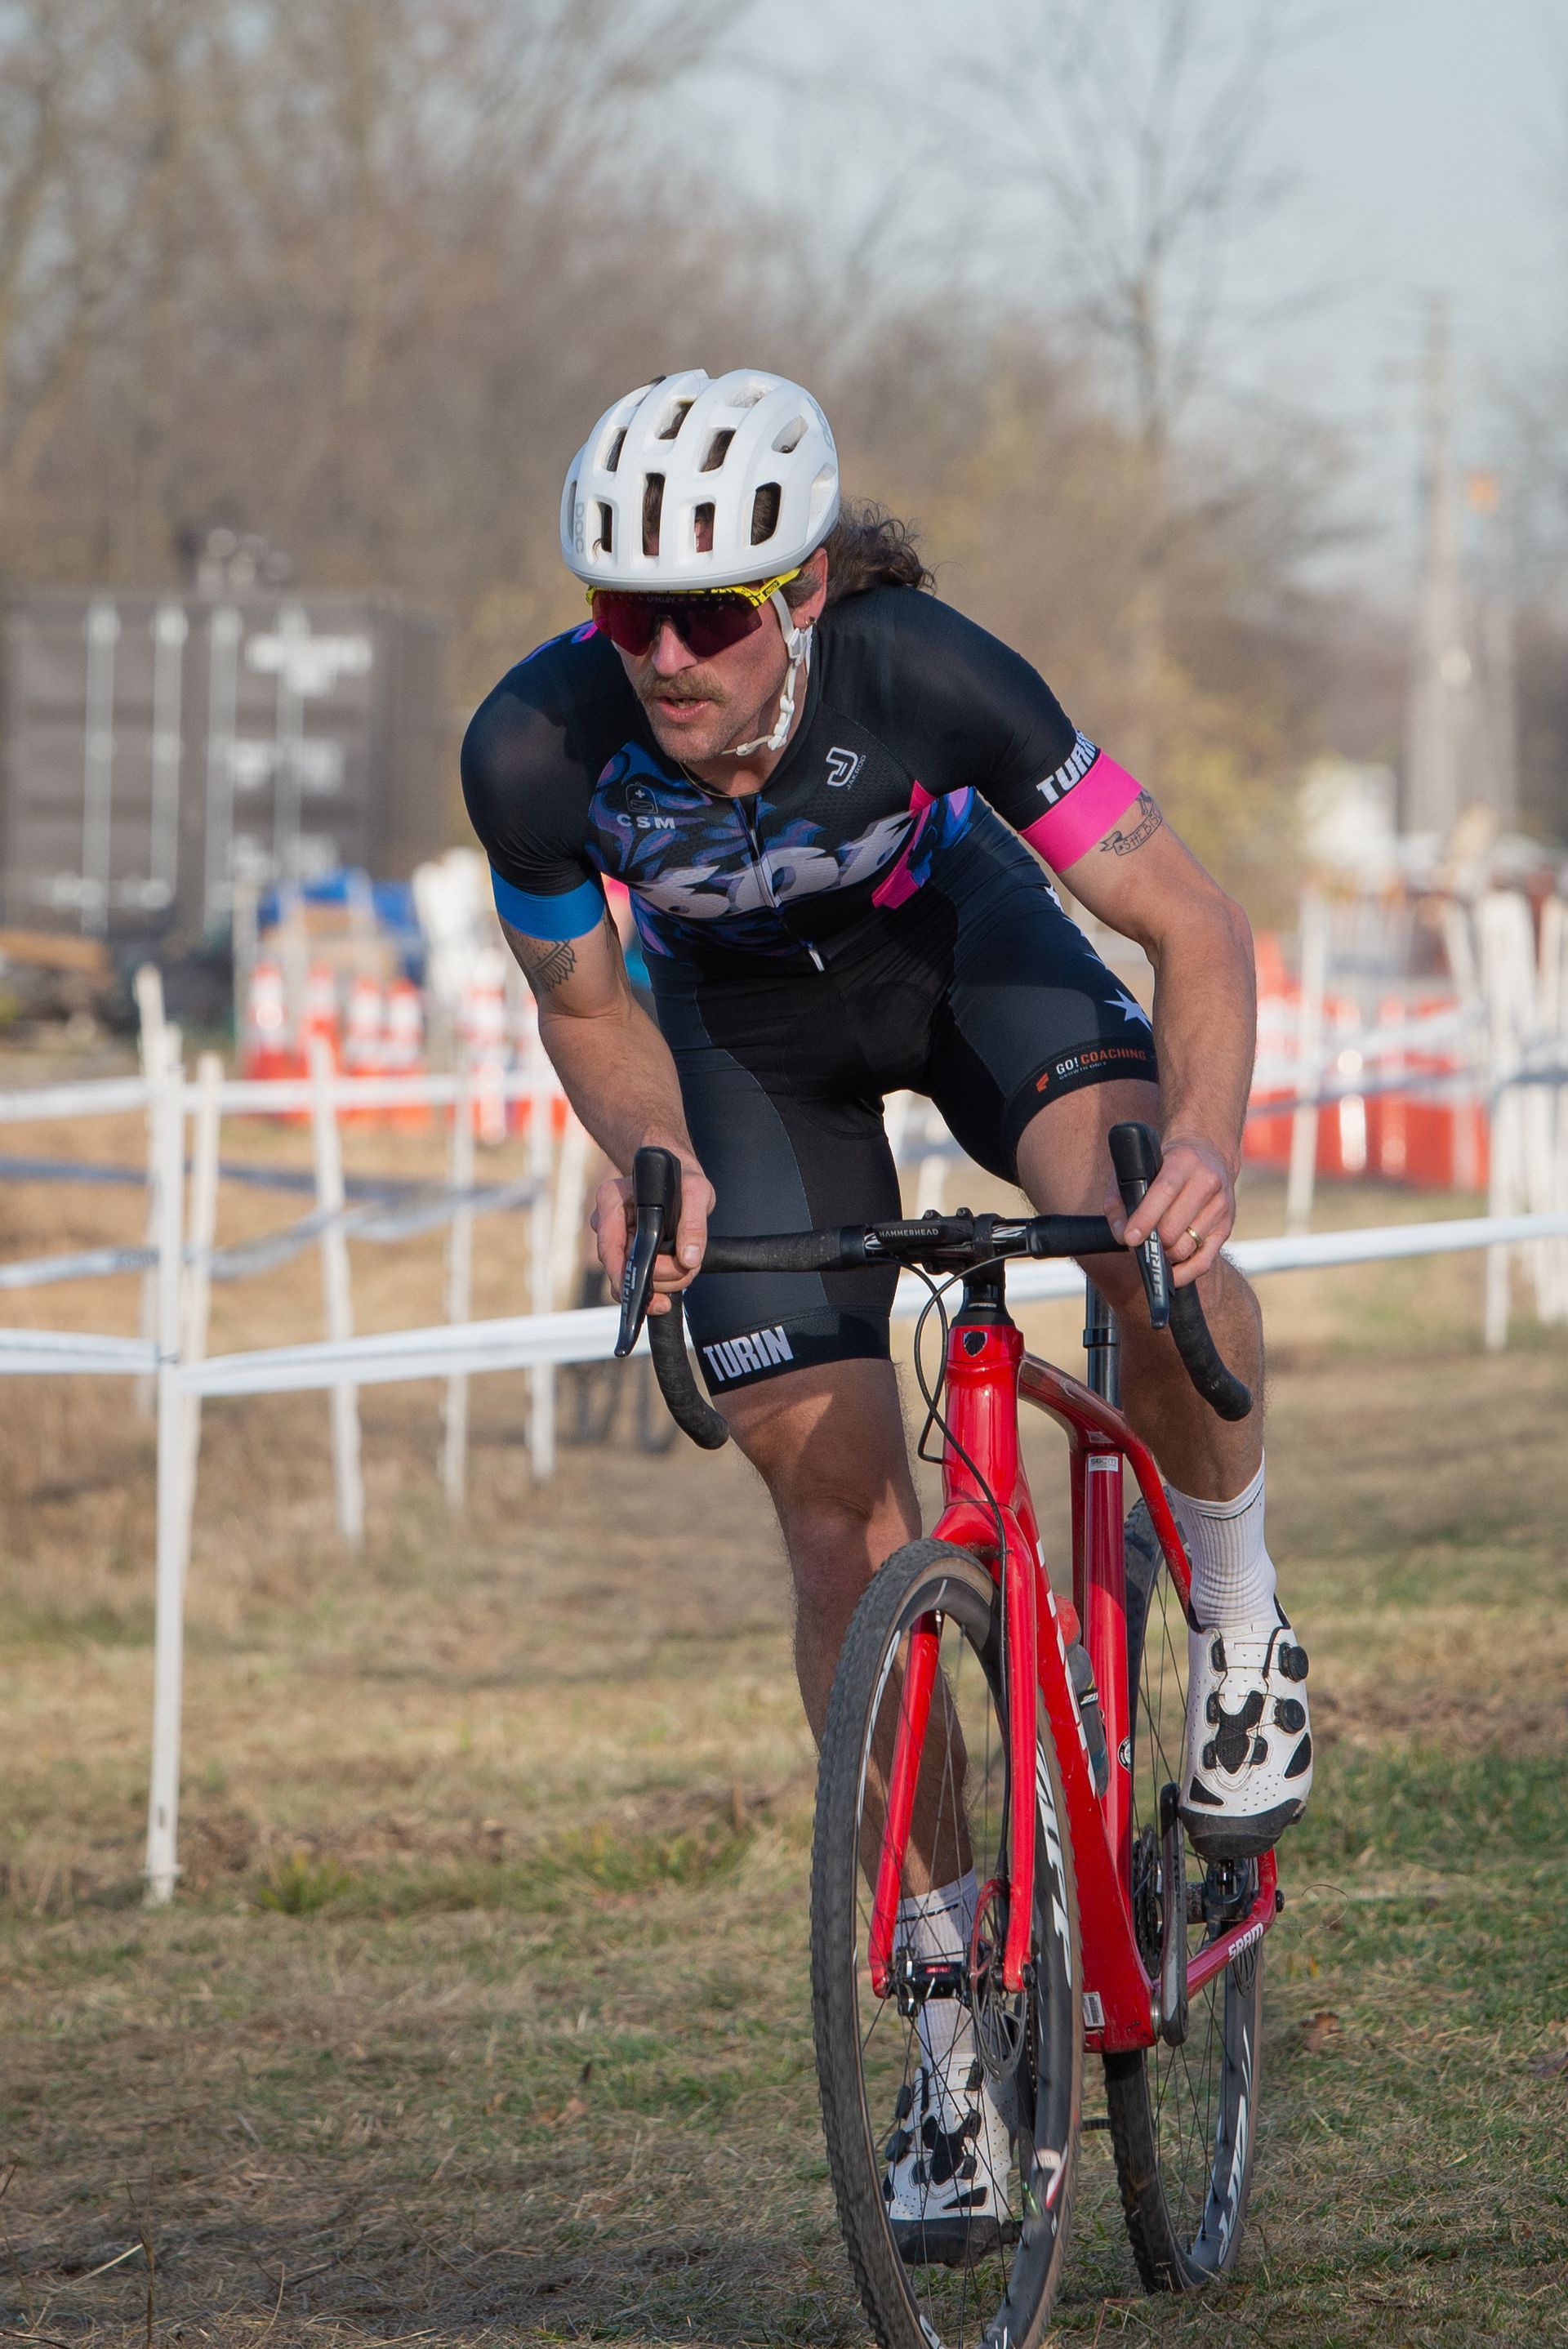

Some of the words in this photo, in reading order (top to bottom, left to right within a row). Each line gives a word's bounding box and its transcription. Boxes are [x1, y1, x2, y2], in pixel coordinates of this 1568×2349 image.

[617, 813, 676, 830] CSM
[1056, 1057, 1079, 1075] GO!
[879, 1228, 939, 1237] HAMMERHEAD
[702, 1326, 794, 1382] TURIN
[1227, 1922, 1264, 1962] SRAM
